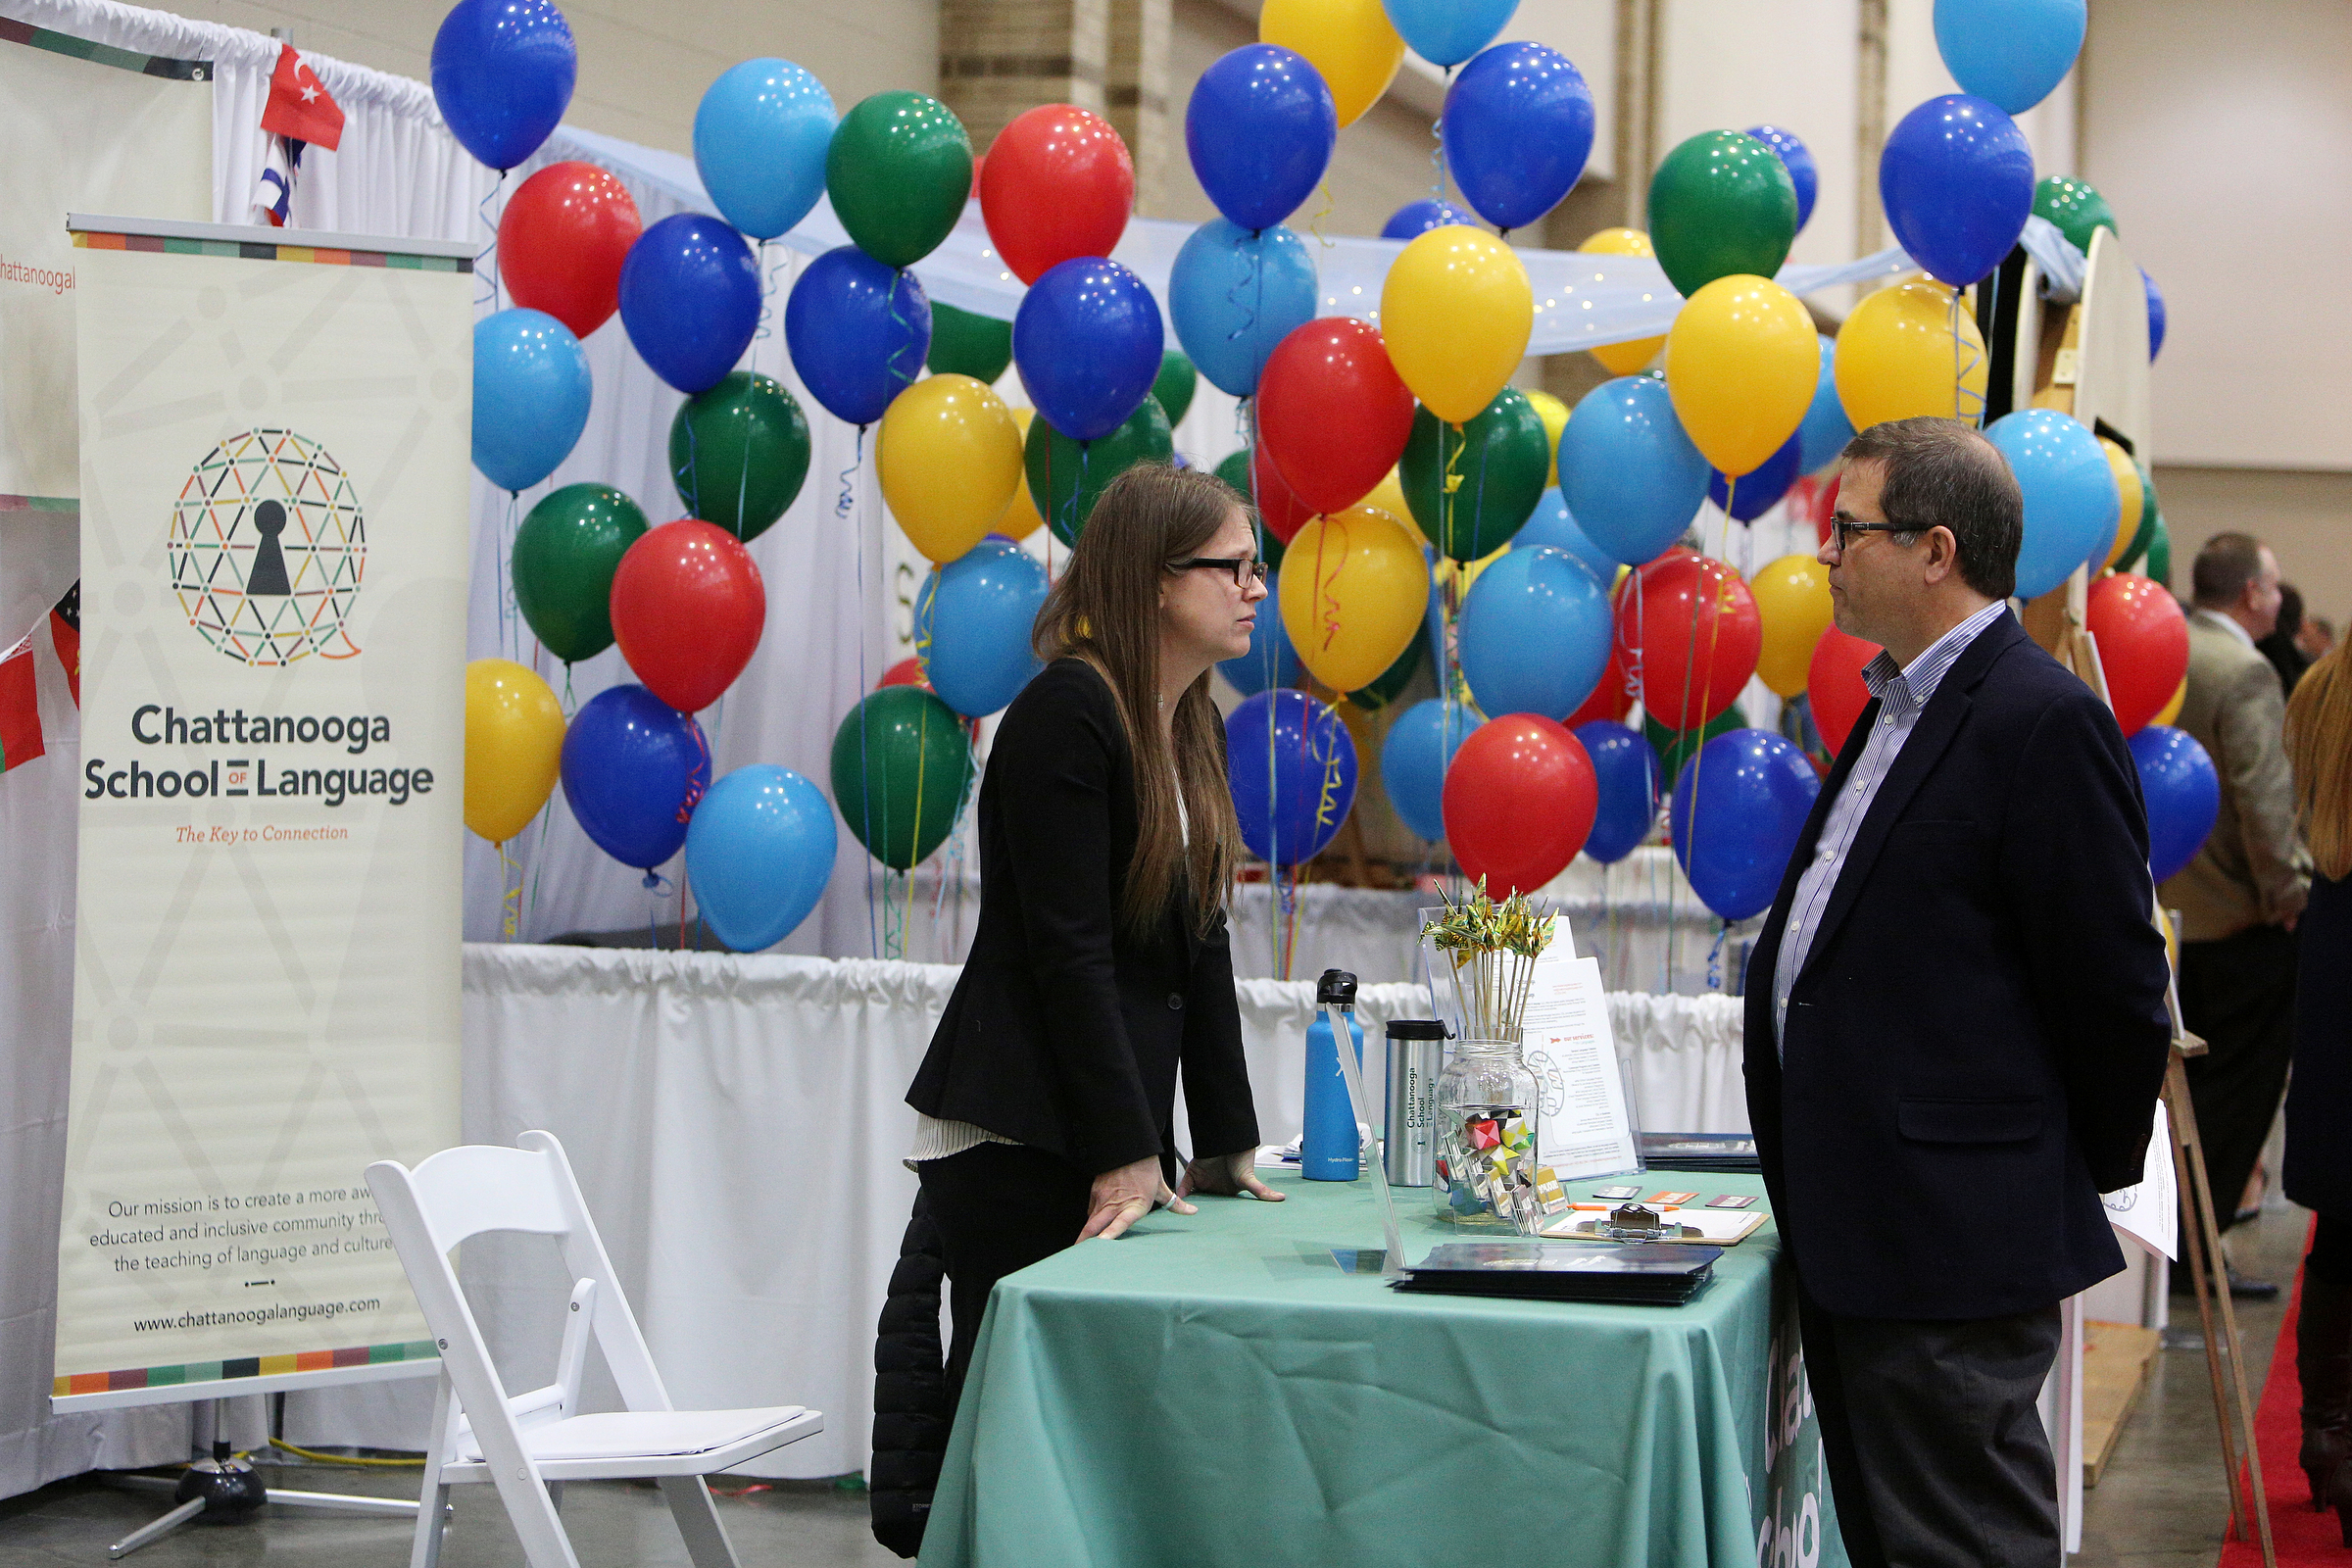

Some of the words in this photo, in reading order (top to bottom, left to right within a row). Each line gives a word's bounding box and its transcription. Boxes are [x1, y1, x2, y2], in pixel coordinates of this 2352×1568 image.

[131, 705, 391, 755] Chattanooga
[84, 759, 219, 800] School
[228, 771, 248, 785] OF
[257, 760, 434, 807] Language
[176, 825, 206, 843] The
[209, 825, 239, 846] Key
[243, 828, 258, 842] to
[263, 824, 349, 842] Connection
[1407, 1067, 1417, 1128] Chattanooga
[108, 1200, 139, 1217] Our
[144, 1198, 202, 1215] mission
[208, 1195, 220, 1210] is
[224, 1196, 240, 1209] to
[245, 1192, 291, 1208] create
[296, 1192, 304, 1204] a
[309, 1188, 347, 1203] more
[352, 1186, 373, 1200] aw
[89, 1224, 164, 1247] educated
[170, 1222, 198, 1241] and
[204, 1218, 269, 1238] inclusive
[272, 1211, 355, 1232] community
[114, 1254, 139, 1272] the
[145, 1250, 212, 1270] teaching
[217, 1246, 233, 1264] of
[237, 1245, 308, 1265] language
[312, 1237, 339, 1255] and
[133, 1298, 380, 1332] www.chattanoogalanguage.com
